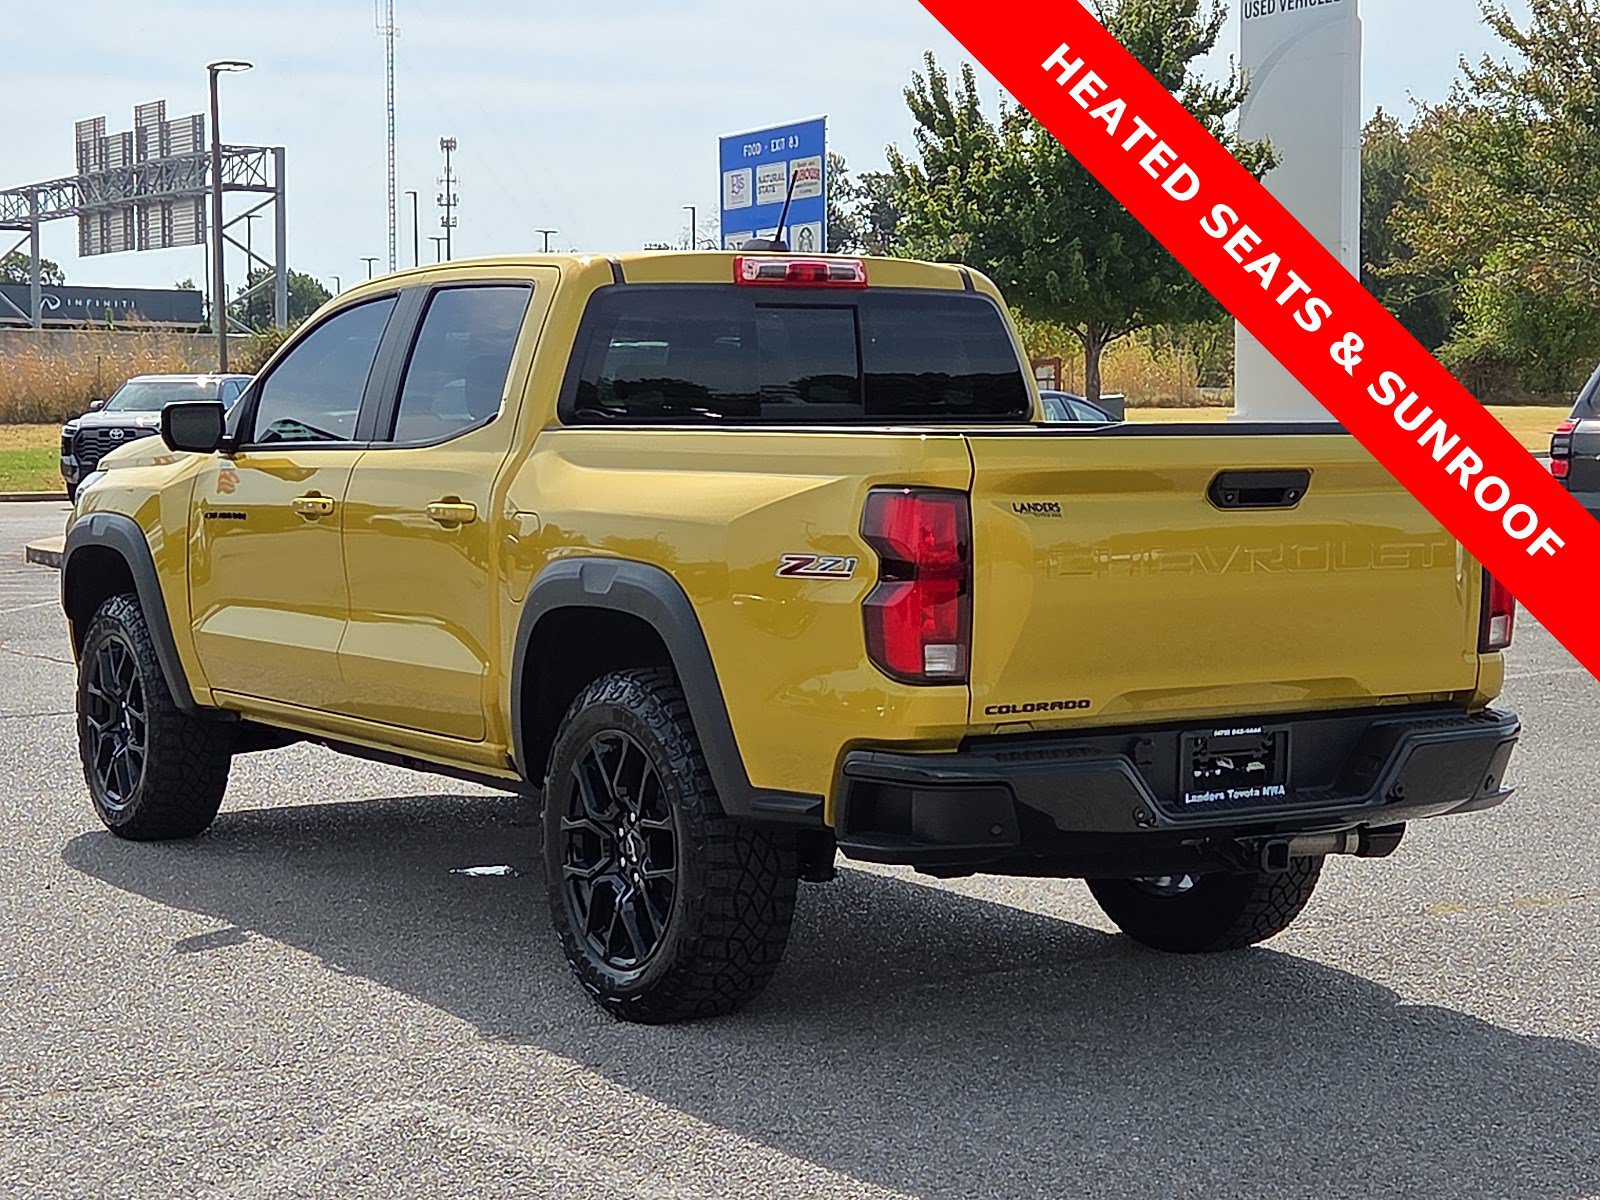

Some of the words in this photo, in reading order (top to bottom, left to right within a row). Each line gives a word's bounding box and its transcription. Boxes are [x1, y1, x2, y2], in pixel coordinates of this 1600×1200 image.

[1245, 0, 1276, 19] USED
[743, 142, 762, 157] FOOD
[770, 137, 786, 152] EXIT
[758, 172, 786, 184] NATURAL
[758, 185, 776, 195] STATE
[67, 298, 135, 309] INFINITI
[1012, 502, 1061, 514] LANDERS
[775, 554, 858, 580] Z71
[1046, 540, 1448, 578] CHEVROLET
[984, 699, 1091, 715] COLORADO
[1185, 791, 1225, 804] Landers
[1227, 787, 1260, 799] Toyota
[1262, 784, 1286, 797] NWA
